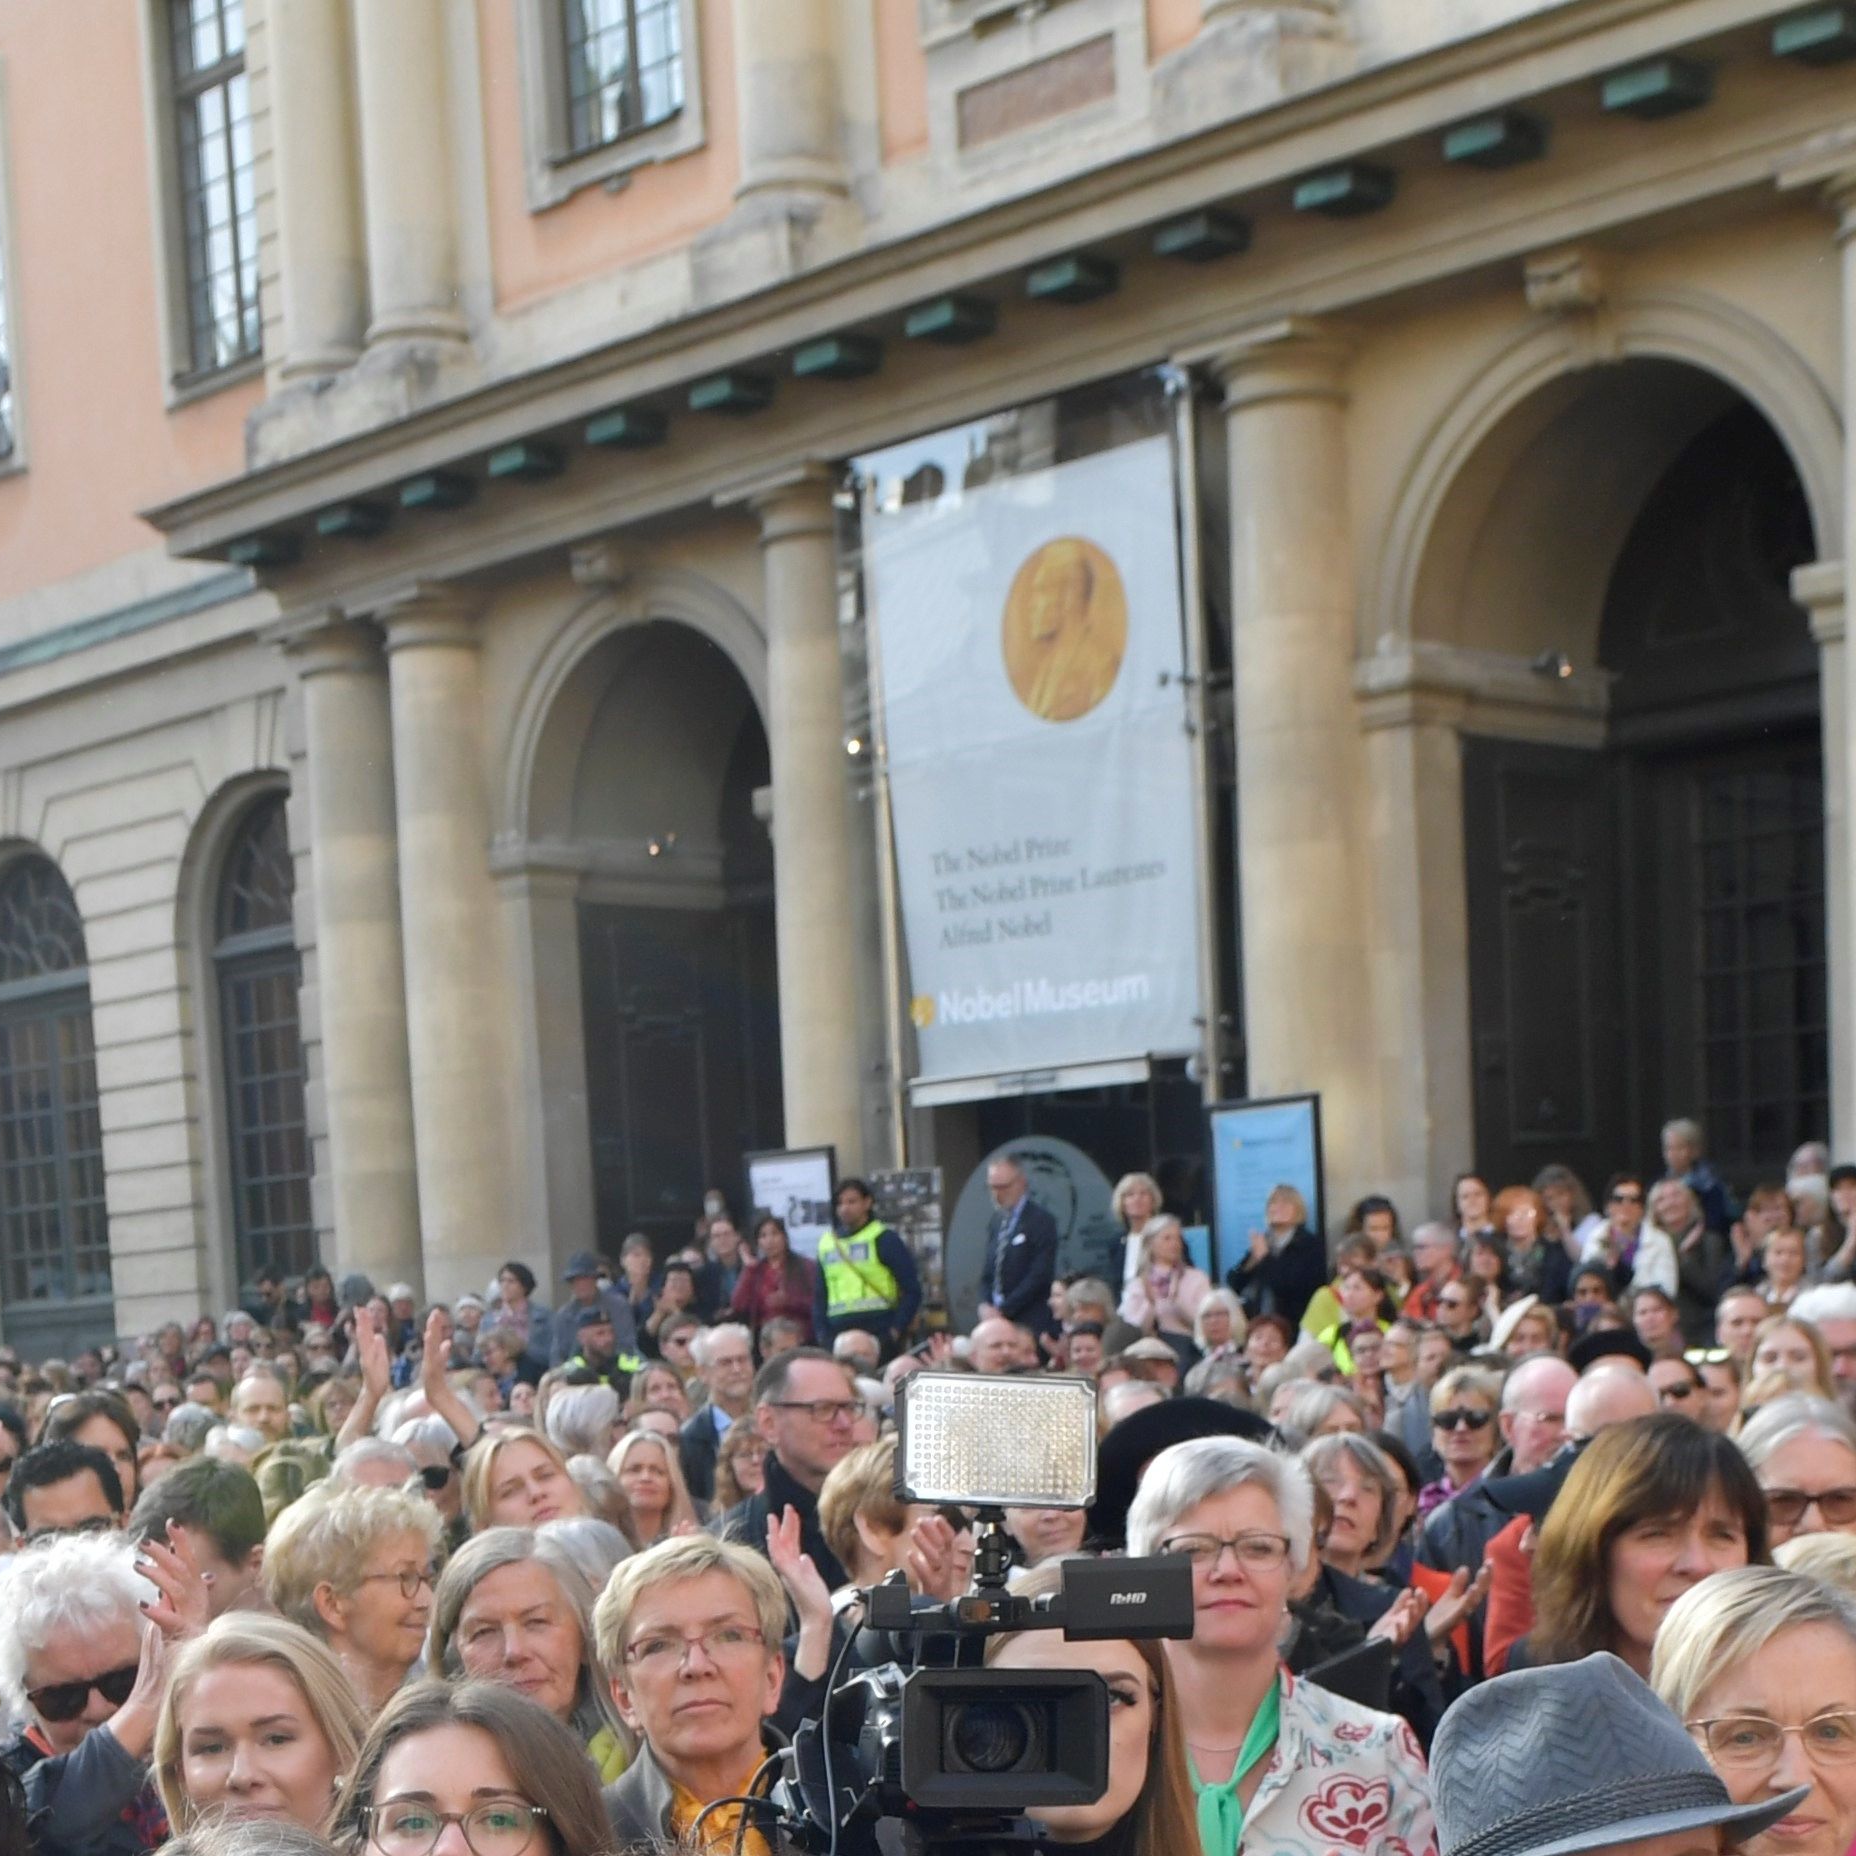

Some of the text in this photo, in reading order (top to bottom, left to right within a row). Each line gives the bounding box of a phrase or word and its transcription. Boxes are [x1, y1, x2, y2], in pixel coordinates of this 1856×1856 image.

[967, 840, 1020, 871] Nobel
[1025, 837, 1072, 862] Prize
[972, 877, 1025, 907] Nobel
[1030, 875, 1075, 898] Prize
[998, 911, 1053, 942] Nobel
